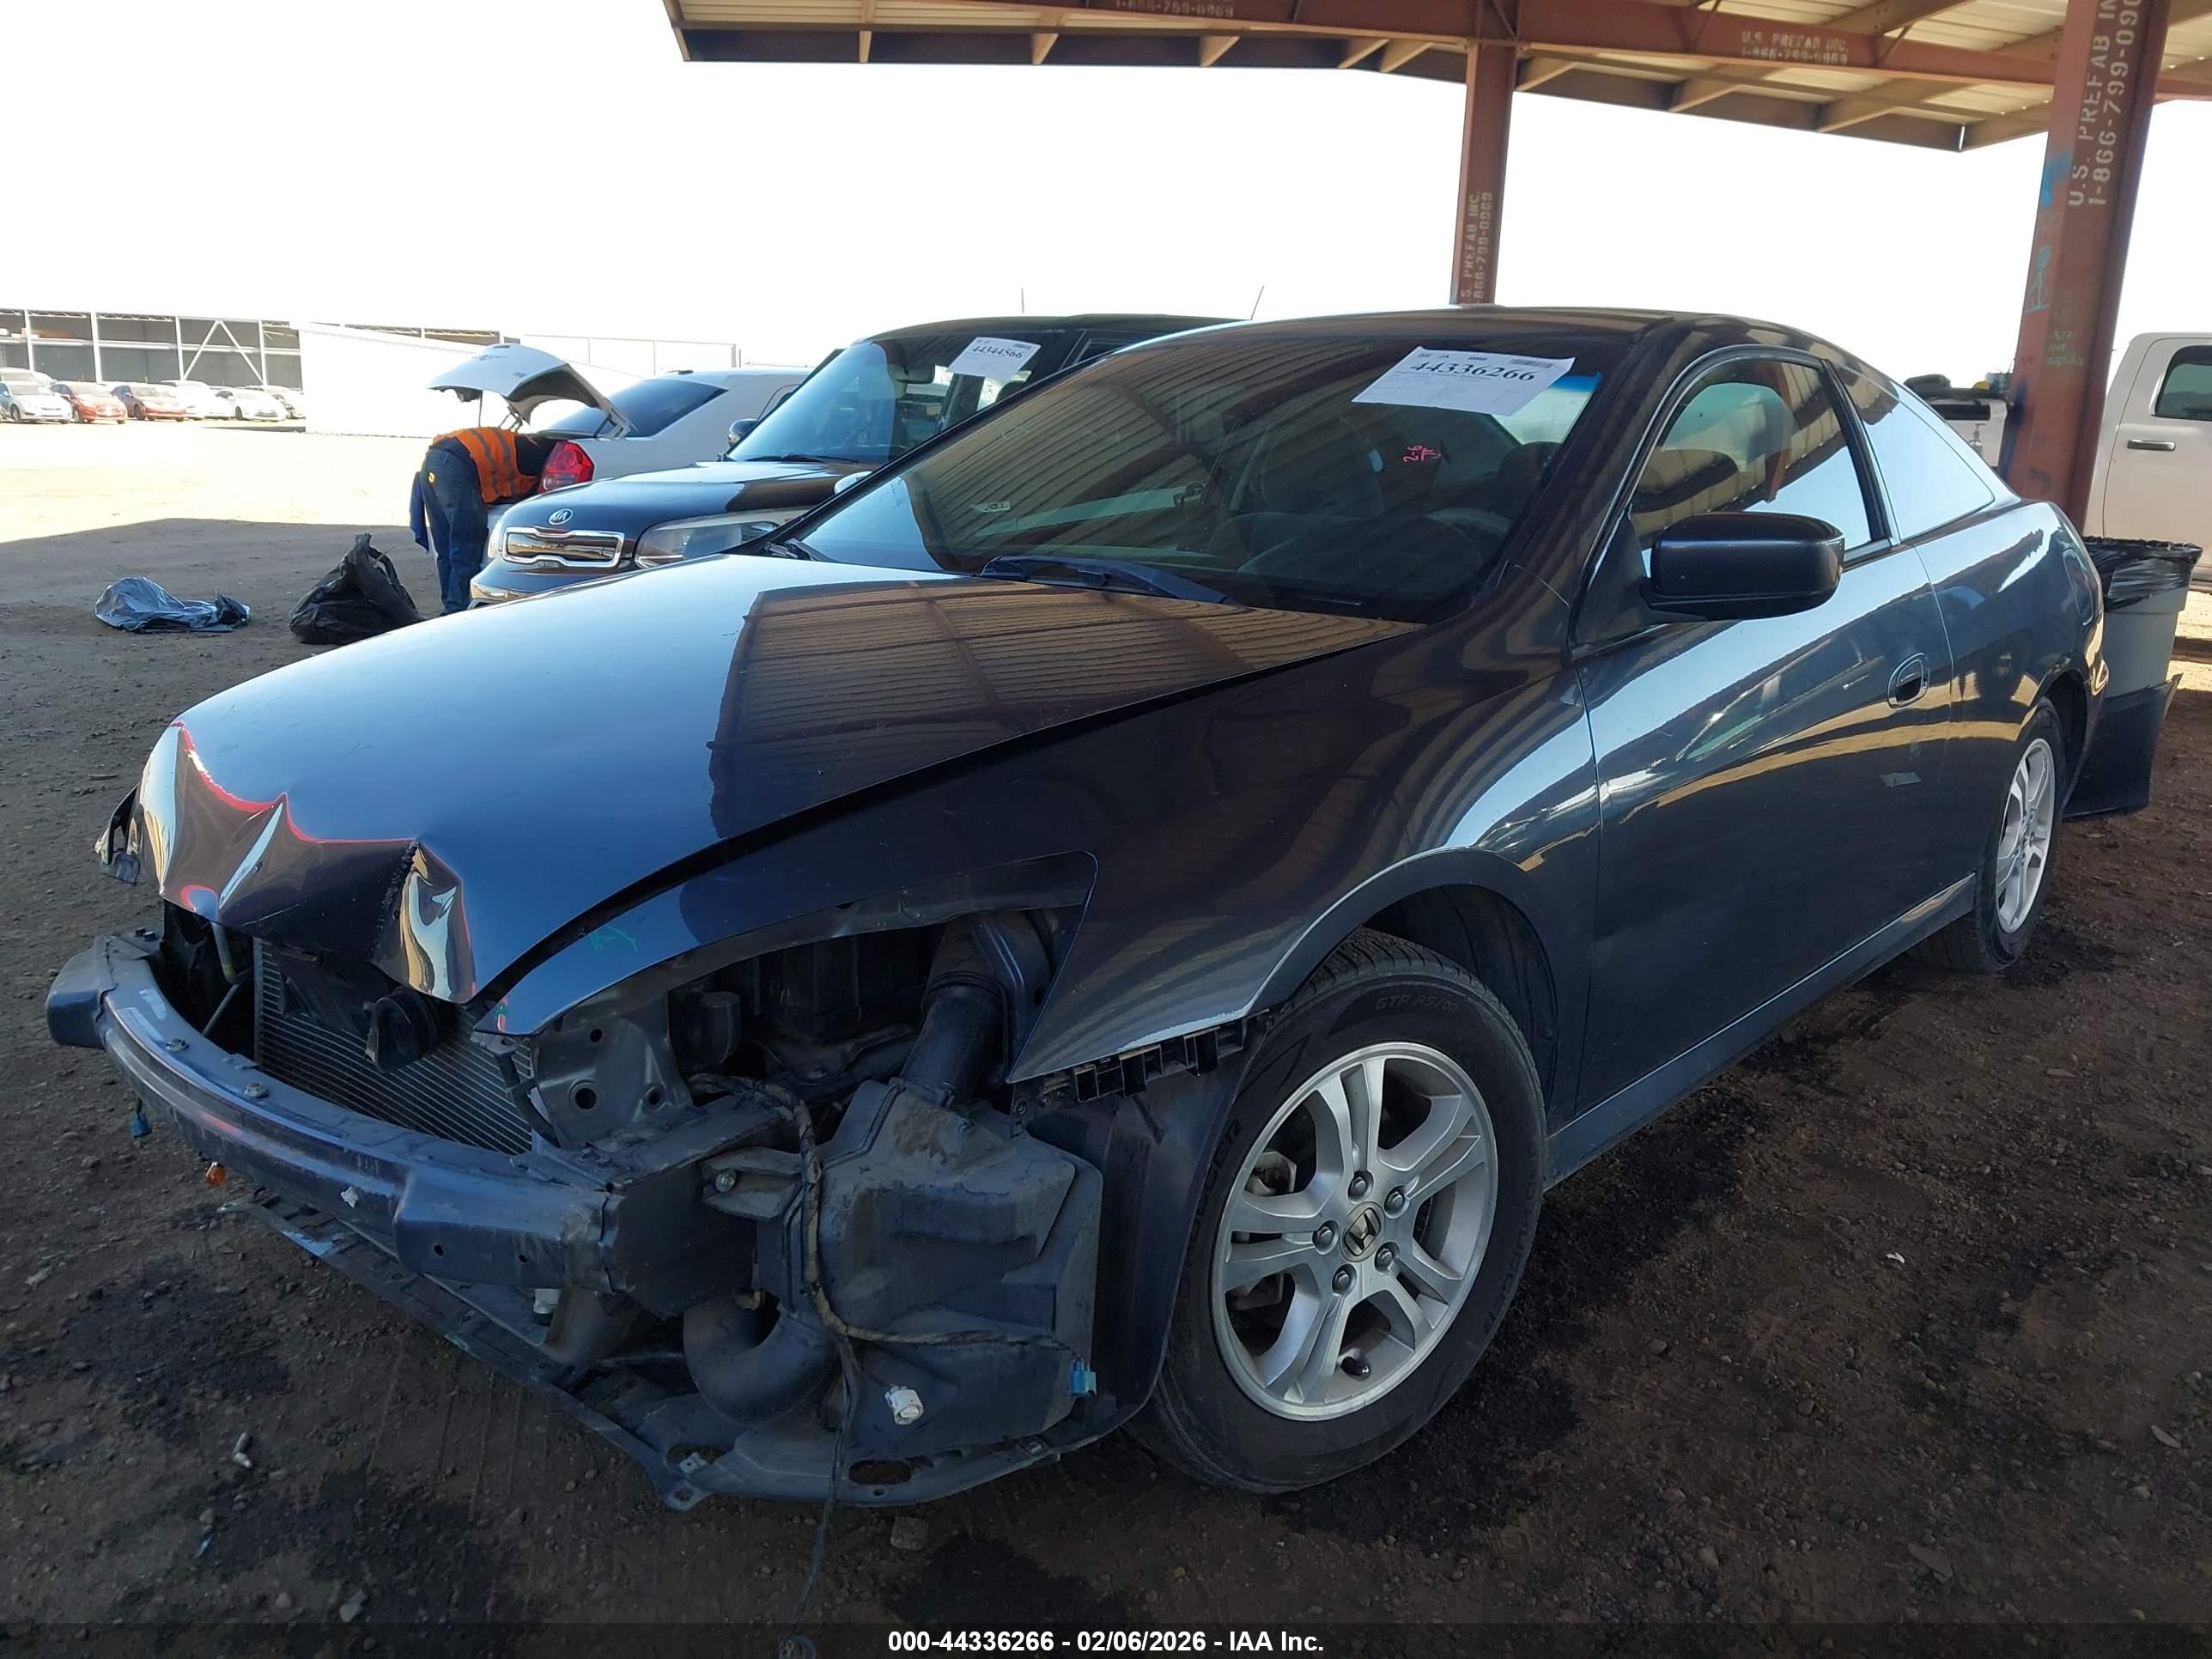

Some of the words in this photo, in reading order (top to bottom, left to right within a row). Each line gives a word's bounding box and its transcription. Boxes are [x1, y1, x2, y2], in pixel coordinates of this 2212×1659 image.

[2078, 35, 2111, 140] PREFAB
[2069, 158, 2092, 205] U.S.
[1463, 224, 1477, 277] PREFAB
[972, 345, 1023, 359] 44344566
[1410, 361, 1540, 382] 44336266
[550, 510, 570, 522] KIA
